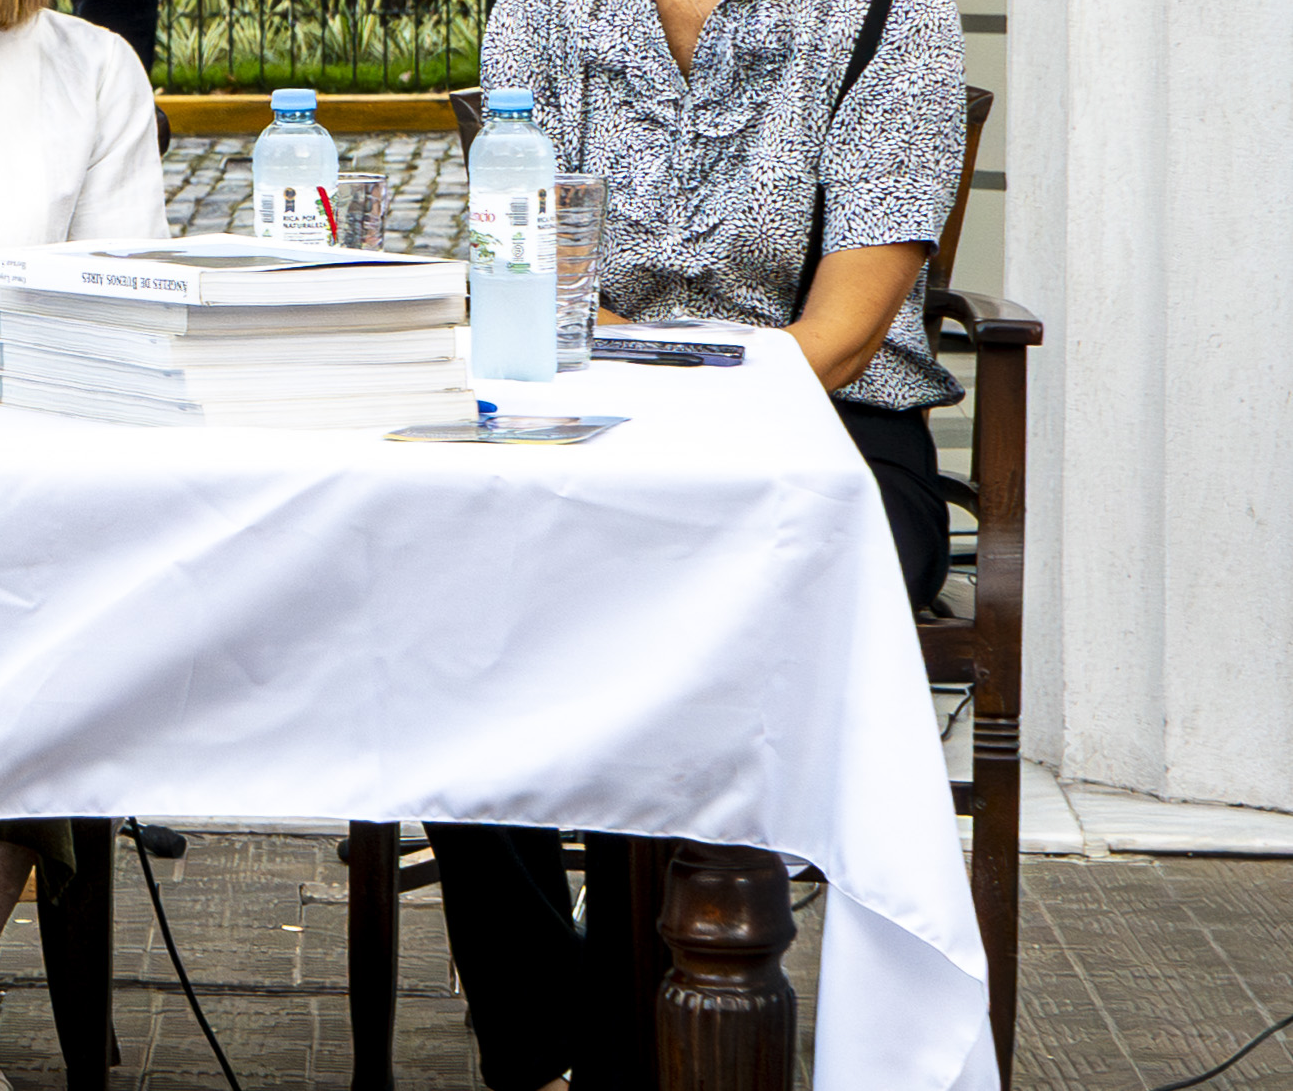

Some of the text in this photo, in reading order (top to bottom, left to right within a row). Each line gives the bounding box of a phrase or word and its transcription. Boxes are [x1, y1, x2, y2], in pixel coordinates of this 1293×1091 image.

[81, 272, 104, 286] AIRES
[106, 274, 138, 290] BUENOS
[140, 277, 151, 289] DE
